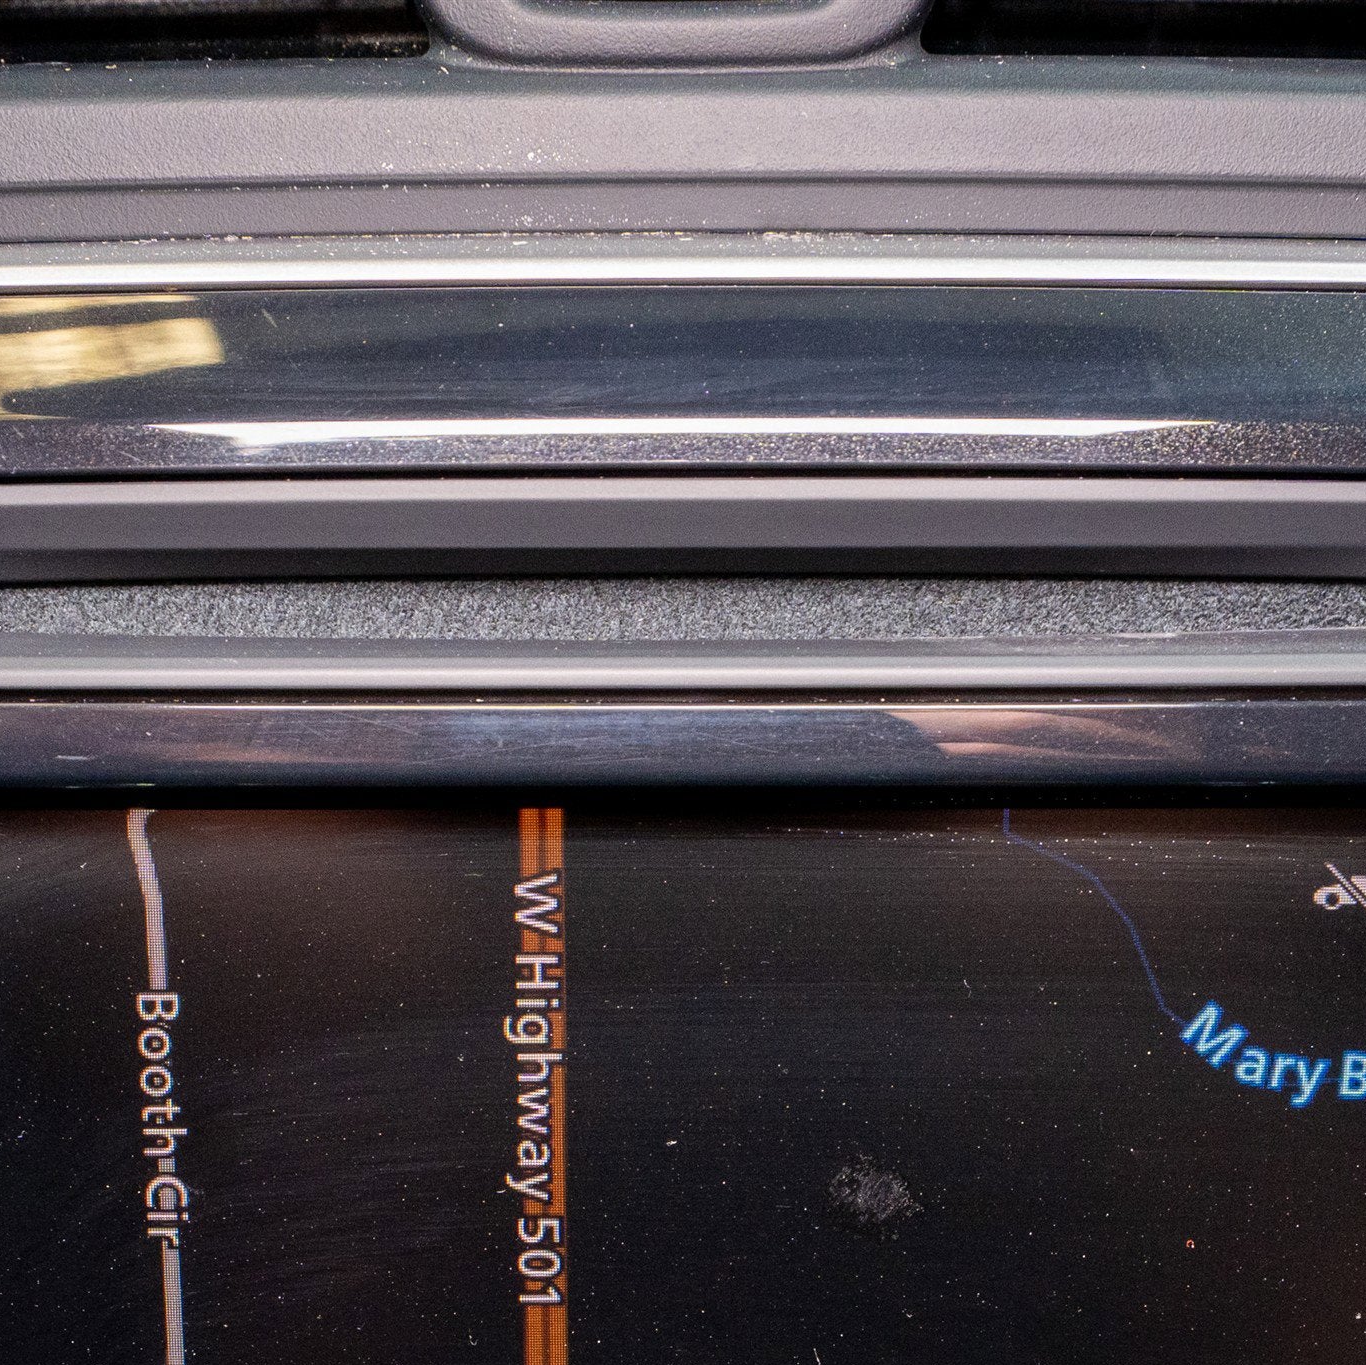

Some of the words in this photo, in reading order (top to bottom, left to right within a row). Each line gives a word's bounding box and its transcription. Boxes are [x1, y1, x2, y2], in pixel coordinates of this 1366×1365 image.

[514, 873, 560, 935] W
[135, 992, 188, 1158] Booth
[504, 953, 564, 1202] Highway
[1180, 1001, 1330, 1108] Mary
[146, 1176, 190, 1249] Cir
[516, 1216, 563, 1305] 501
